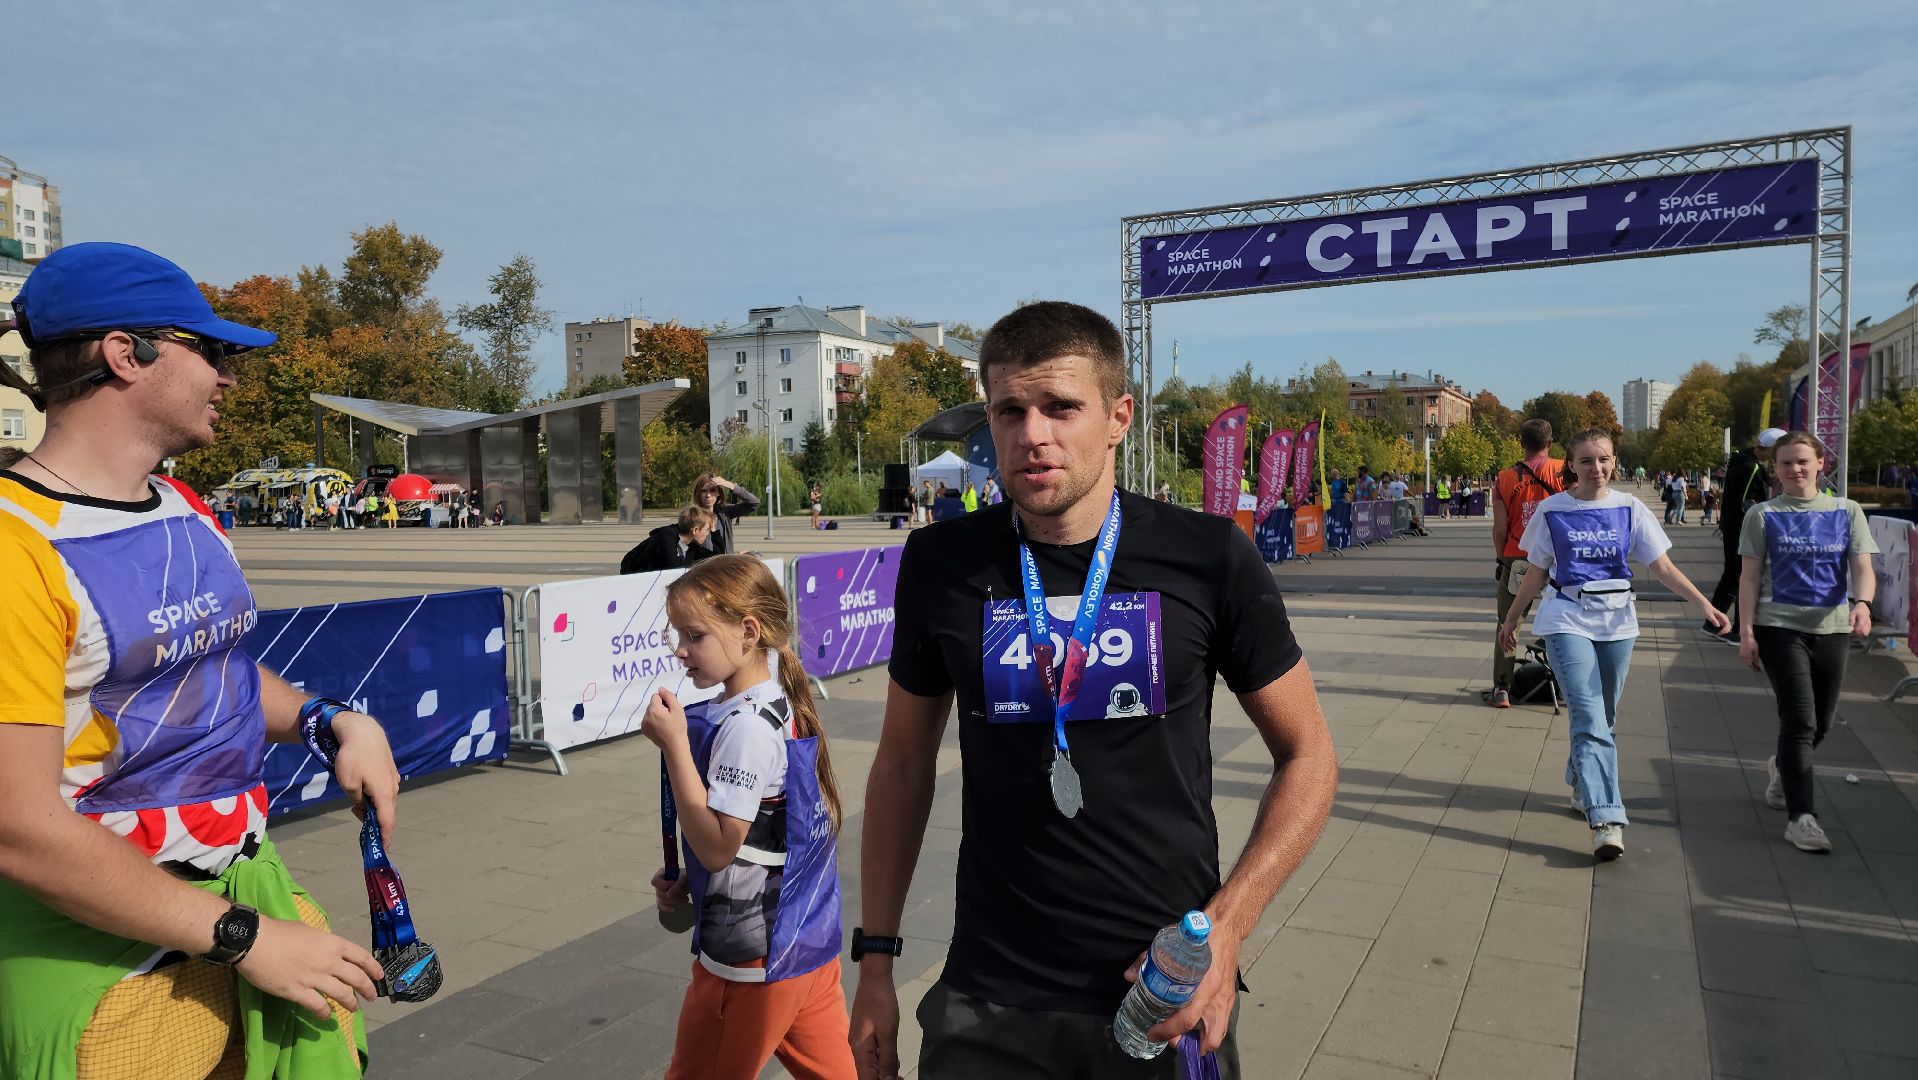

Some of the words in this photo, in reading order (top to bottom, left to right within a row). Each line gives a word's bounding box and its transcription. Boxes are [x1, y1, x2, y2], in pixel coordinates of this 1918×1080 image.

[1660, 192, 1718, 210] SPACE
[1306, 196, 1587, 272] СТАРТ
[1168, 249, 1209, 262] SPACE
[1216, 437, 1225, 467] SPACE
[1567, 529, 1618, 542] SPACE
[1778, 535, 1816, 544] SPACE
[1572, 545, 1617, 558] TEAM
[840, 589, 877, 611] SPACE
[1084, 568, 1105, 618] KOROLEV
[147, 591, 222, 634] SPACE
[1032, 596, 1047, 635] SPACE
[307, 715, 319, 750] SPACE
[718, 764, 734, 773] RUN
[368, 826, 382, 860] SPACE
[387, 881, 398, 899] km
